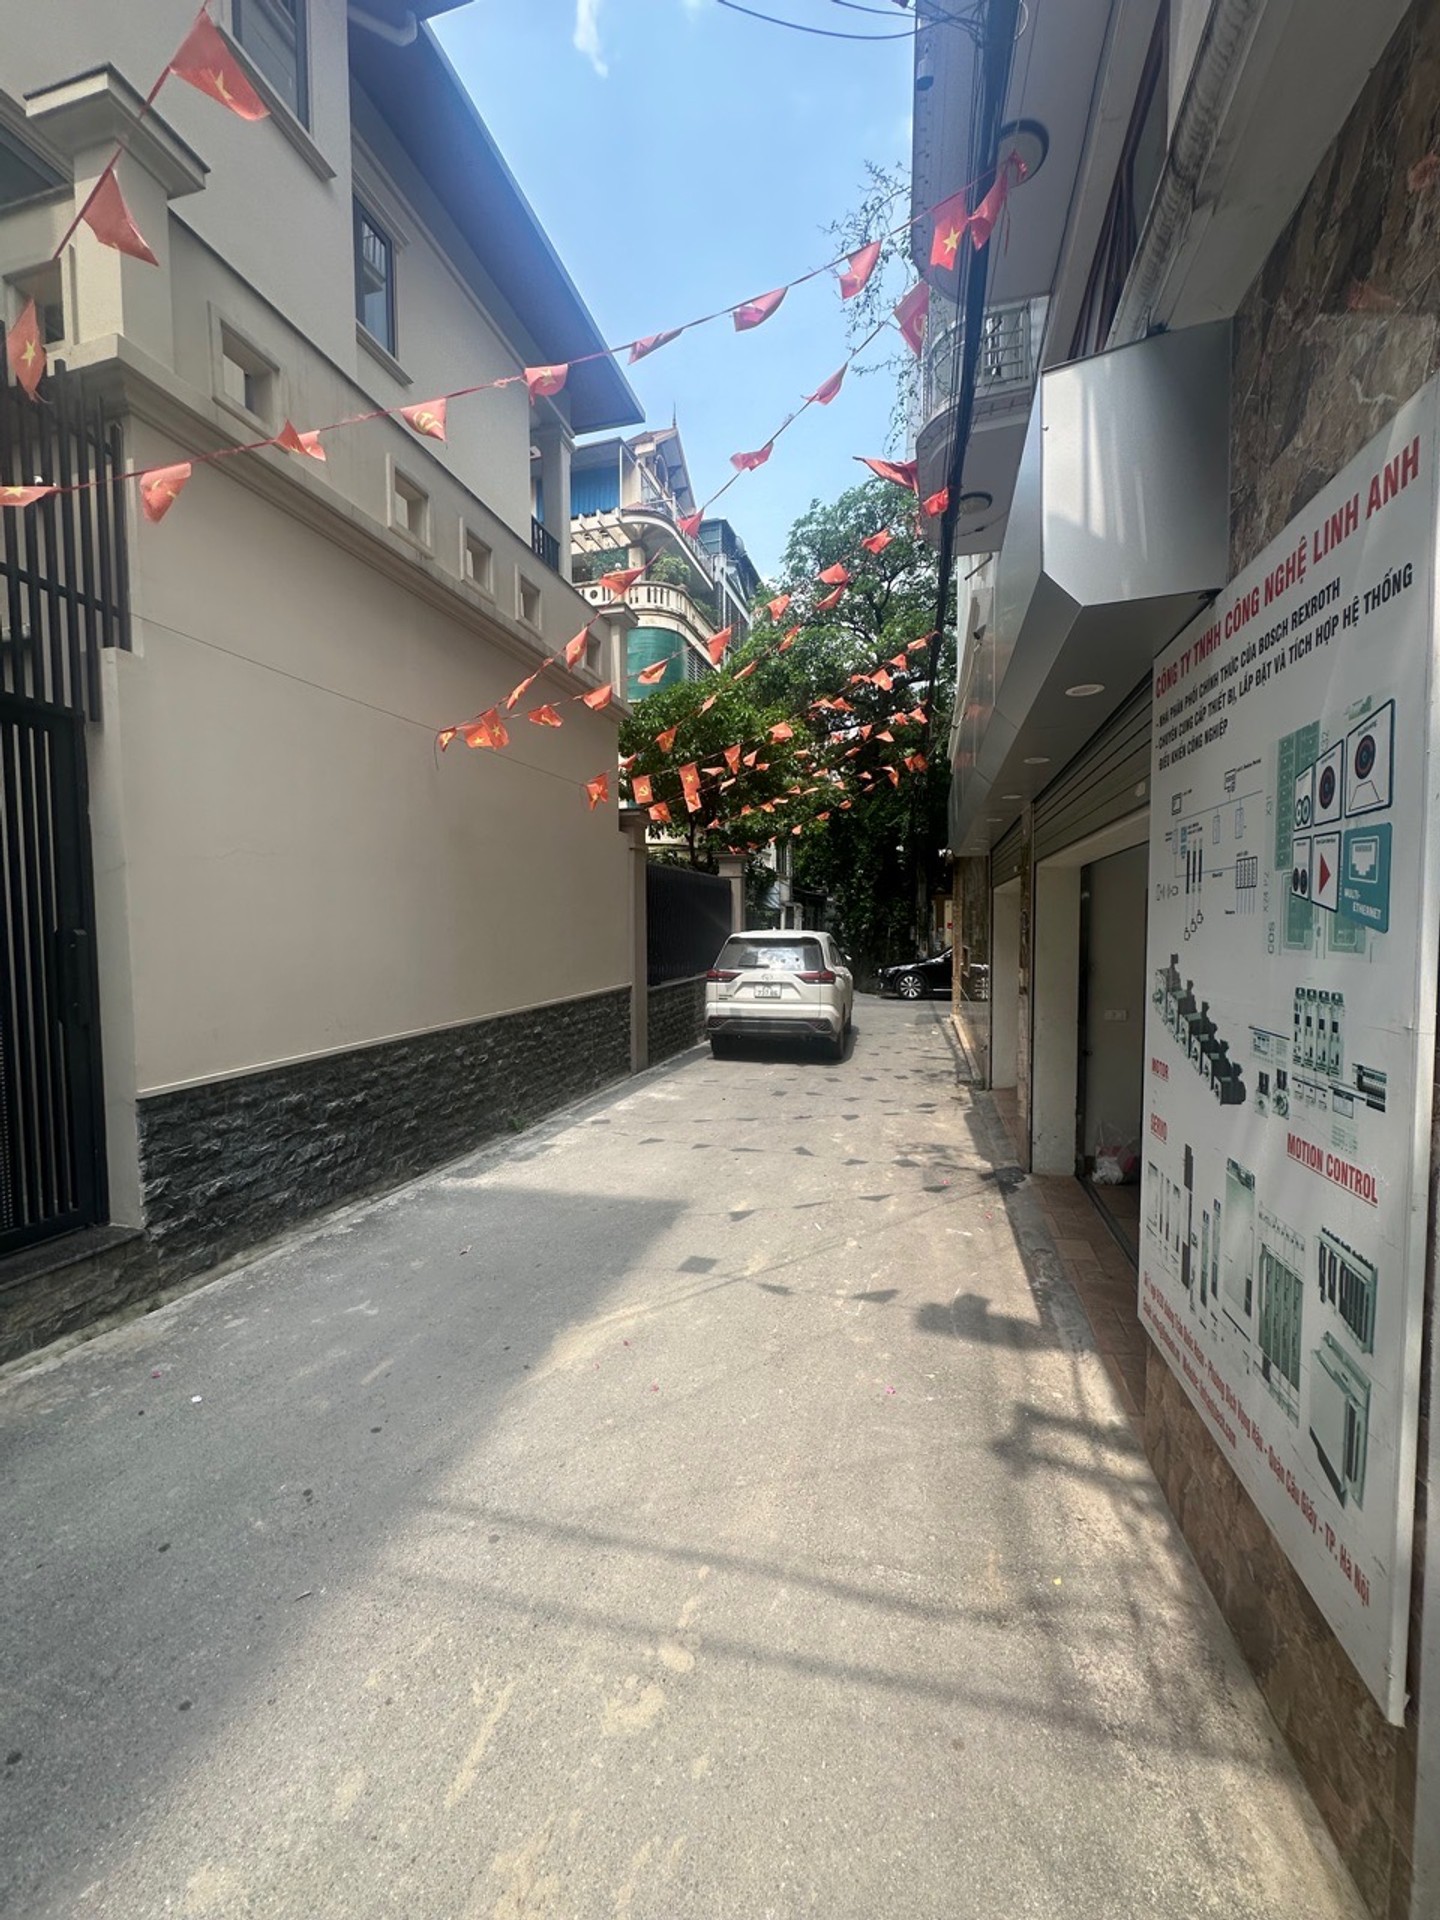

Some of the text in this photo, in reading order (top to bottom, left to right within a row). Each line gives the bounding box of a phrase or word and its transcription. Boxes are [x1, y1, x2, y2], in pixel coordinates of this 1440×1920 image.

[1156, 434, 1420, 698] CÔNG TY TNHH CÔNG NGHỆ LINH ANH
[1194, 703, 1206, 726] CẤP
[1207, 689, 1226, 717] THIẾT
[1255, 659, 1271, 687] ĐẶT
[1273, 648, 1286, 676] VÀ
[1289, 630, 1312, 665] TÍCH
[1315, 611, 1339, 648] HỢP
[1342, 595, 1359, 629] HỆ
[1363, 560, 1412, 616] THỐNG
[1199, 670, 1219, 698] CHÍNH
[1220, 655, 1238, 683] THỨC
[1240, 640, 1256, 668] CỦA
[1258, 616, 1288, 655] BOSCH
[1291, 575, 1340, 631] REXROTH
[1204, 716, 1228, 745] NGHIỆP
[1352, 902, 1382, 920] ETHERNET
[1286, 1130, 1378, 1206] MOTION CONTROL
[1300, 1489, 1316, 1533] Giấy
[1324, 1522, 1338, 1562] TP.
[1339, 1543, 1352, 1582] Hà
[1353, 1563, 1369, 1608] Nội
